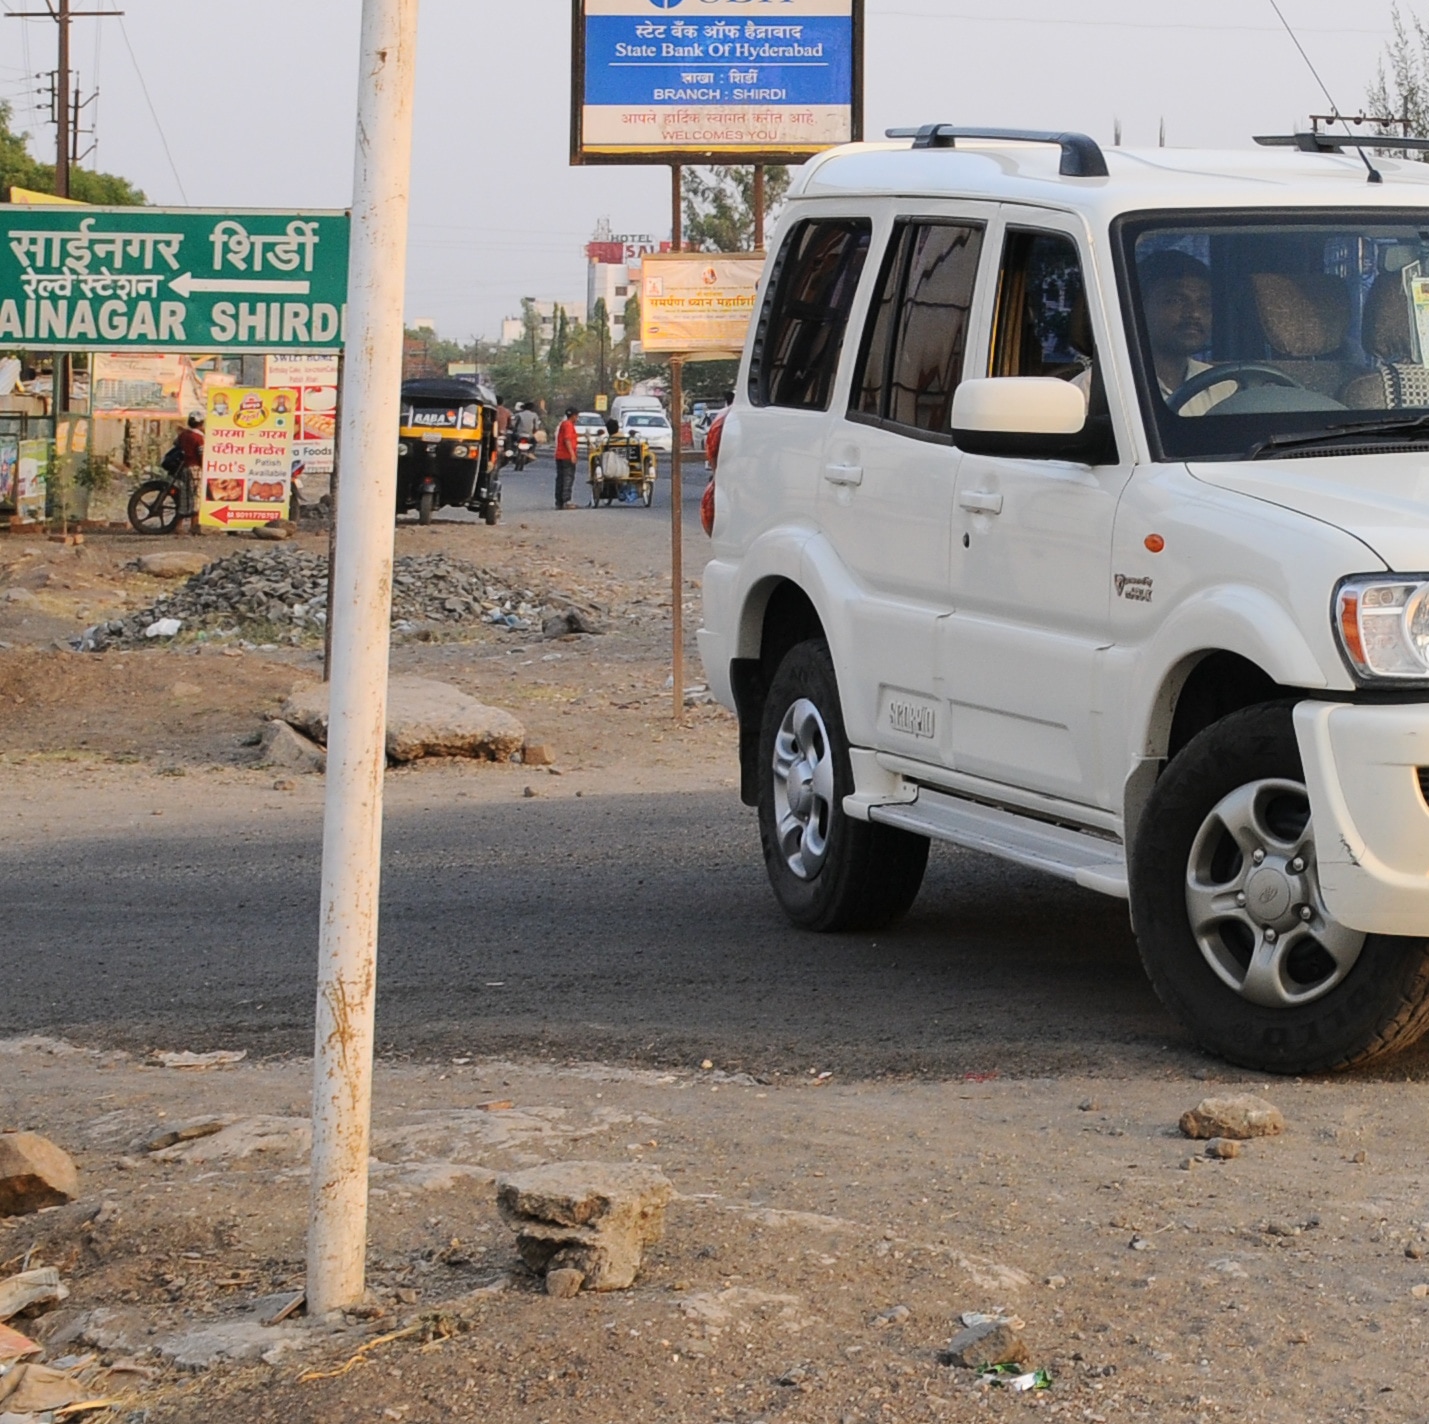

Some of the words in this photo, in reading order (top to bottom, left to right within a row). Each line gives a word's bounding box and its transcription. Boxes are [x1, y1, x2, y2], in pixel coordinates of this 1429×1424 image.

[635, 20, 667, 39] स्टेट
[616, 43, 656, 57] State
[661, 43, 703, 57] Bank
[708, 43, 733, 57] Of
[735, 43, 823, 60] Hyderabad
[653, 88, 721, 101] BRANCH
[733, 88, 786, 101] SHIRDI
[621, 110, 657, 125] आपले
[663, 109, 700, 125] हार्दिक
[706, 111, 746, 125] स्वागत
[662, 129, 744, 141] WELCOMES
[748, 129, 778, 141] YOU
[610, 234, 653, 243] HOTEL
[8, 217, 185, 274] साईनगर
[209, 219, 320, 273] शिर्डी
[0, 299, 187, 340] AINAGAR
[414, 413, 446, 424] BABA
[303, 447, 332, 457] Foods
[206, 460, 246, 474] Hot's
[249, 468, 287, 478] Available
